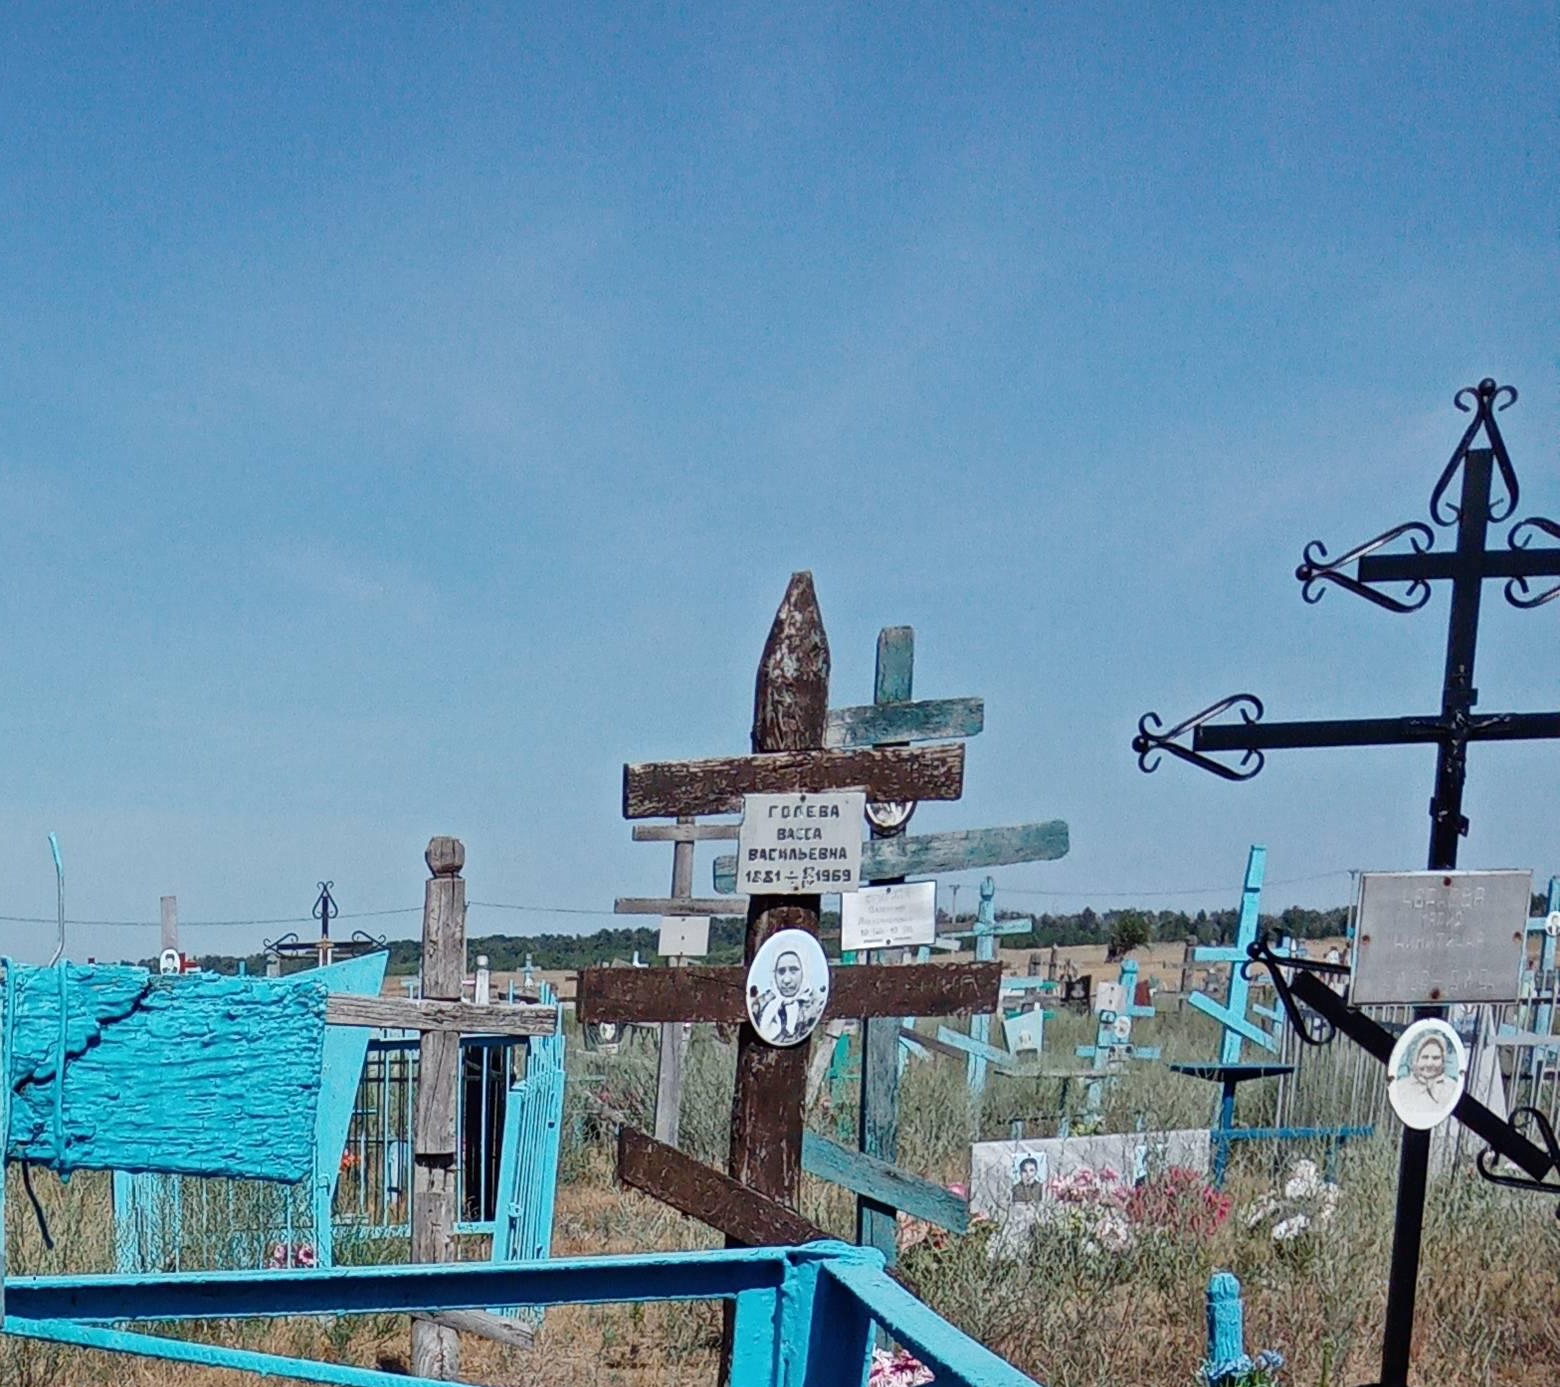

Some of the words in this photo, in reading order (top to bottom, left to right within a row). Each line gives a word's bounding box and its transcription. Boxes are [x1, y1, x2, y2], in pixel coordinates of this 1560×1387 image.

[768, 804, 840, 819] ГОЛЕВА
[777, 827, 822, 841] ВАССА
[748, 846, 847, 861] ВАСИЛЬЕВНА
[816, 869, 851, 882] 1969
